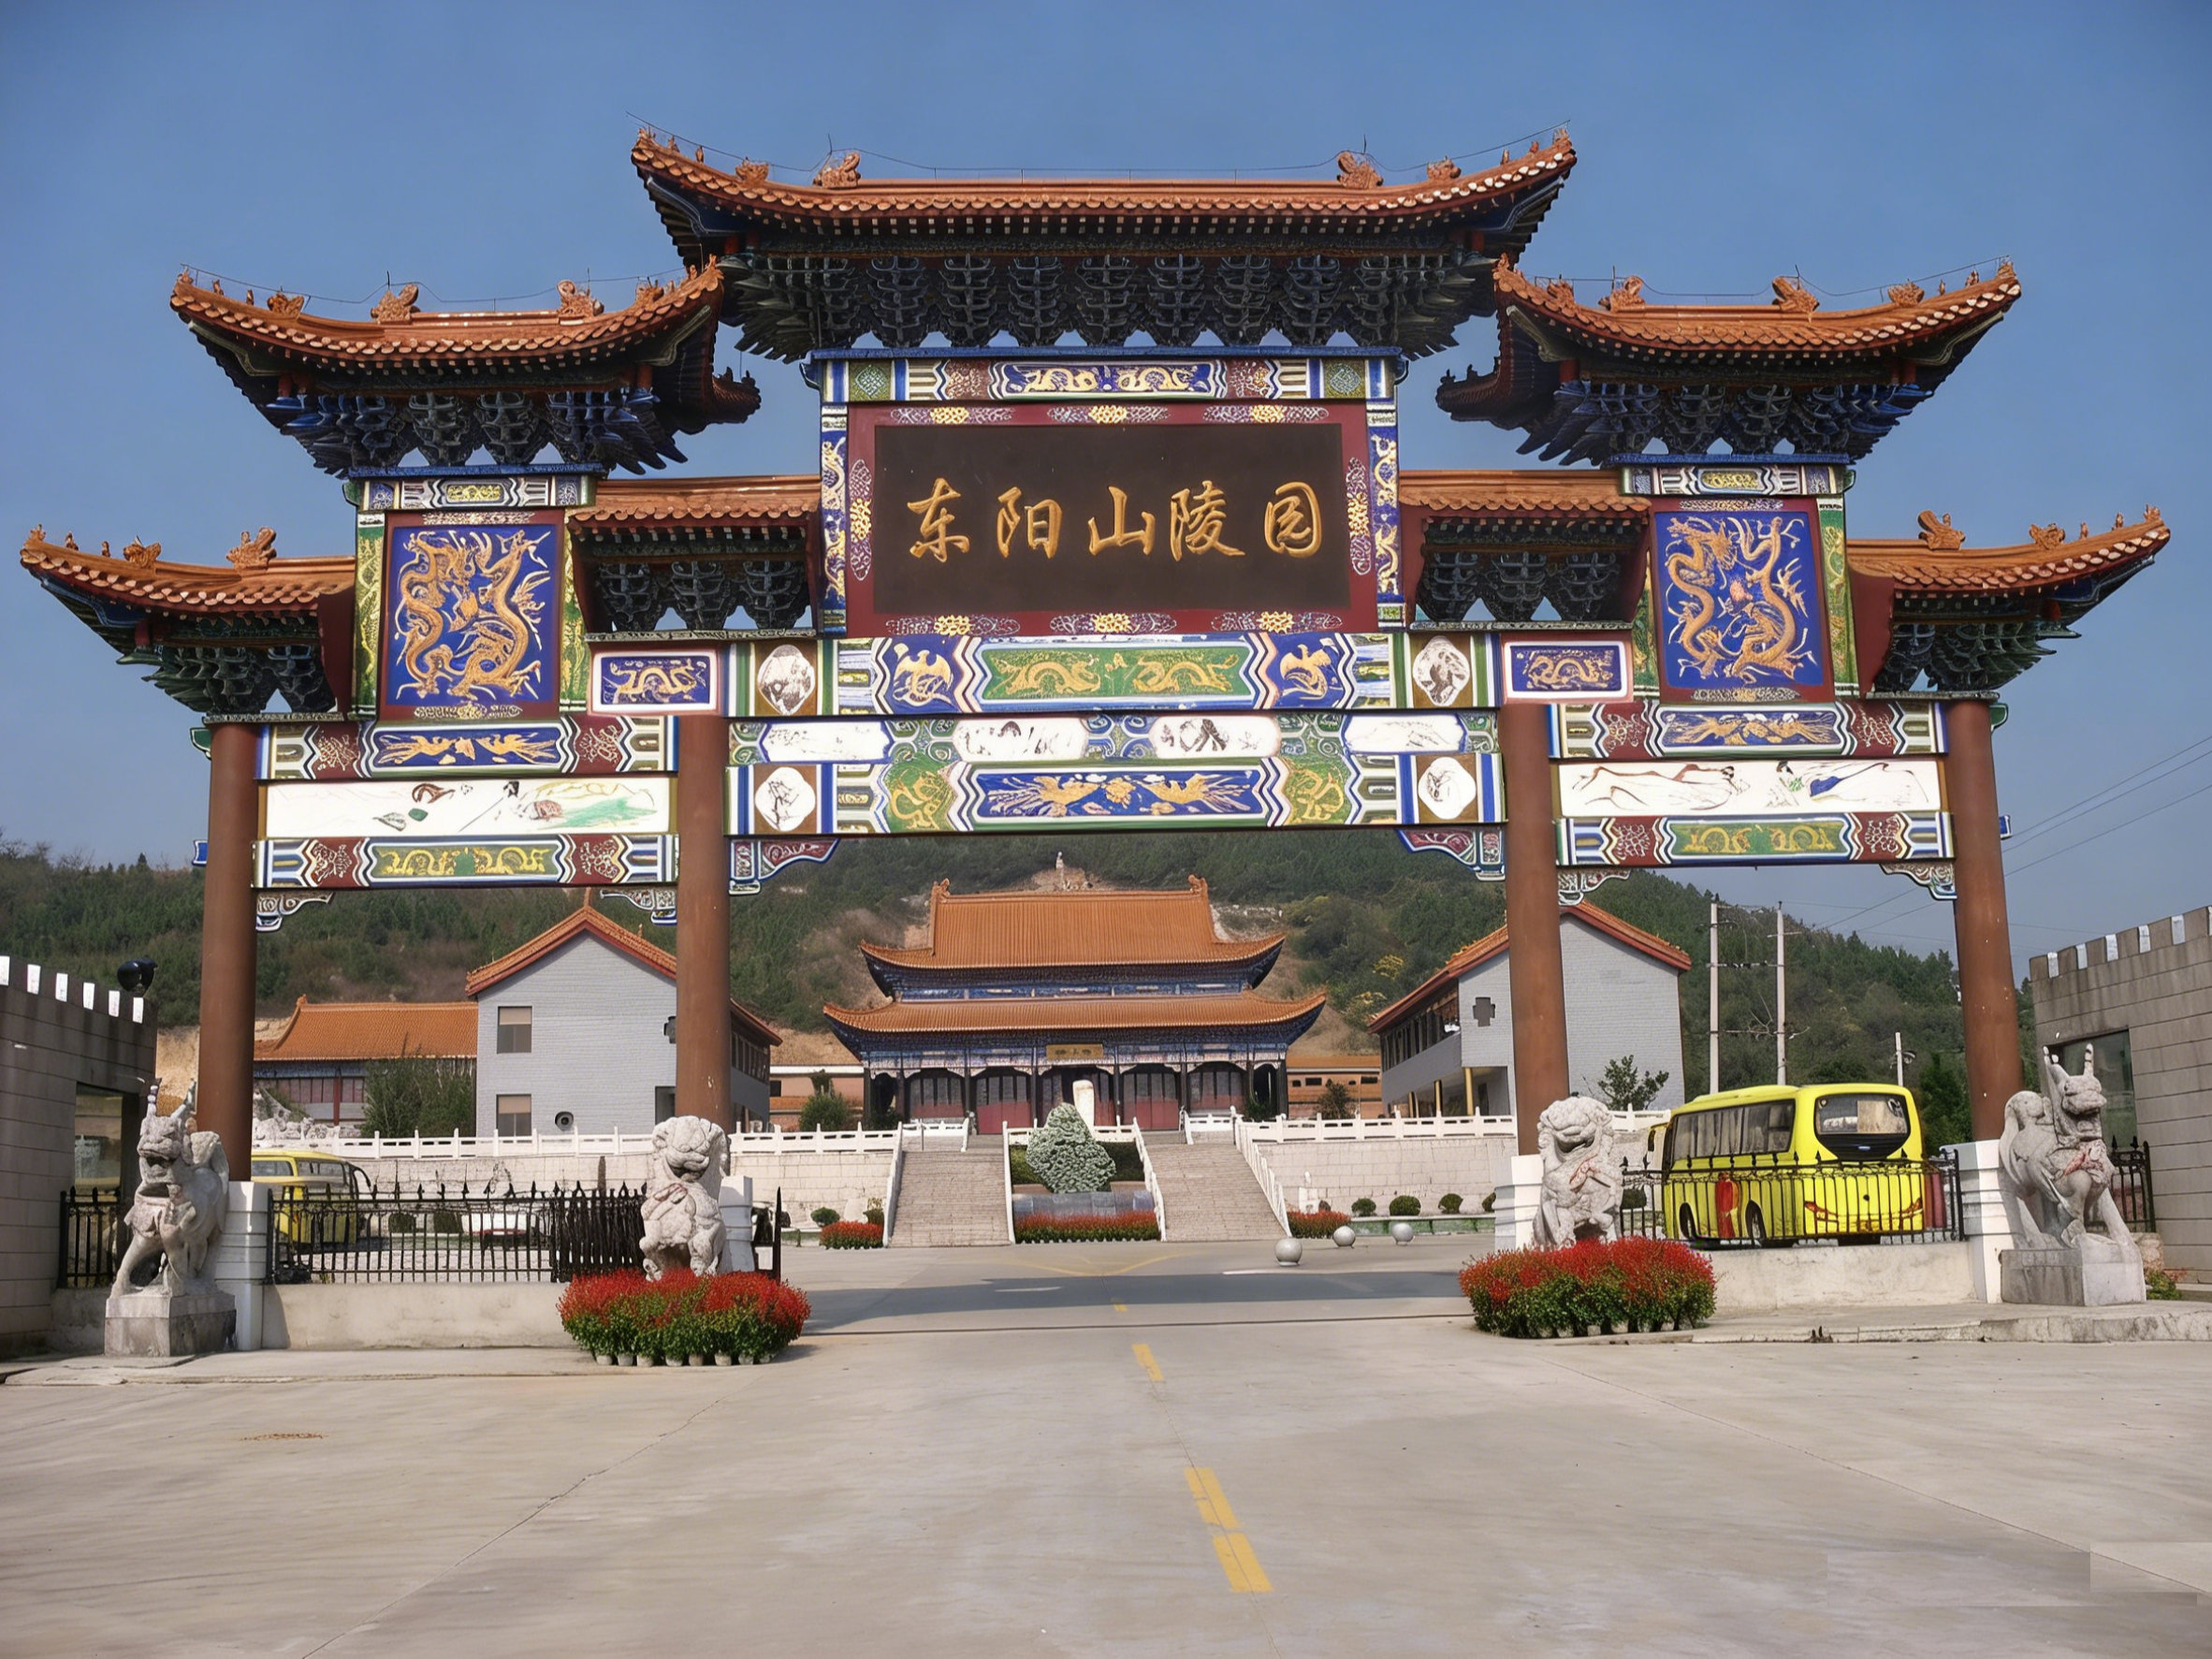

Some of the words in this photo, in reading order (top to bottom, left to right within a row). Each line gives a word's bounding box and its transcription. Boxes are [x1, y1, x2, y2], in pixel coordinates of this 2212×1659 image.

[907, 477, 1322, 562] 东阳山陵园
